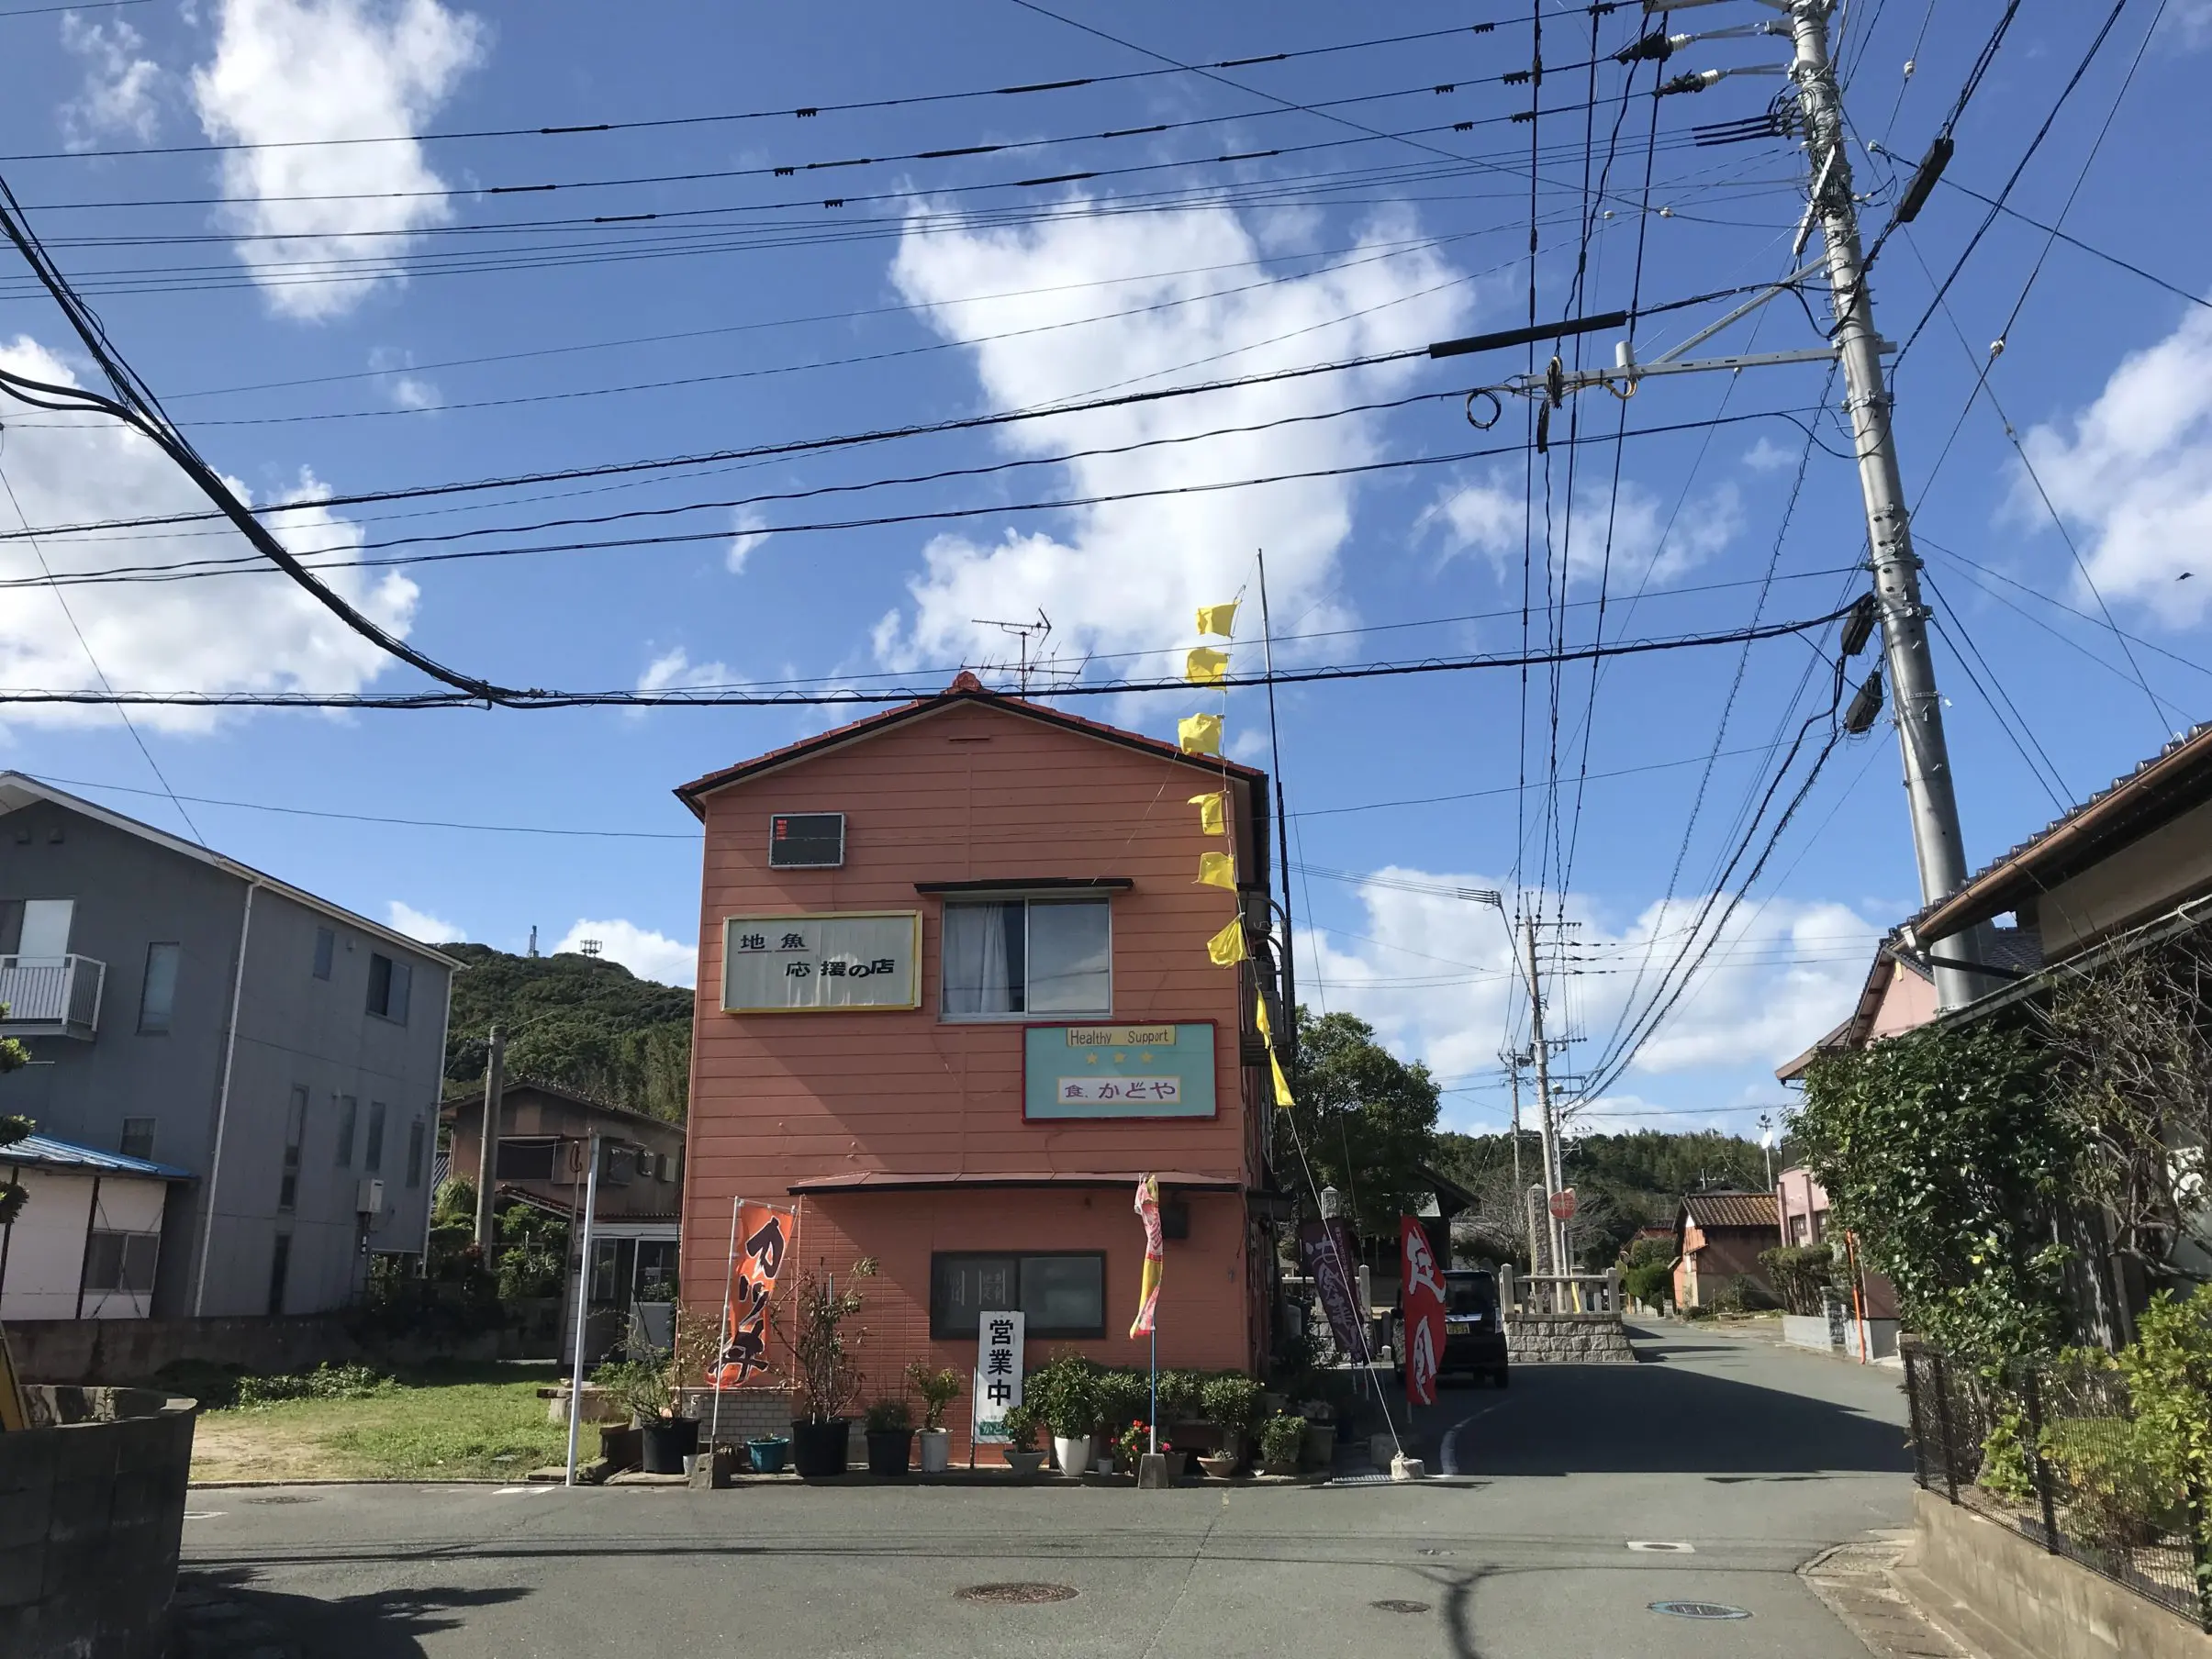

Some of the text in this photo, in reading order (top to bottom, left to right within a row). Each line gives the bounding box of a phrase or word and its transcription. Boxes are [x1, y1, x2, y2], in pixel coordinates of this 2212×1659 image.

[785, 959, 895, 978] 応援の店
[1070, 1030, 1168, 1045] Healthy Support
[987, 1319, 1014, 1407] 営業中
